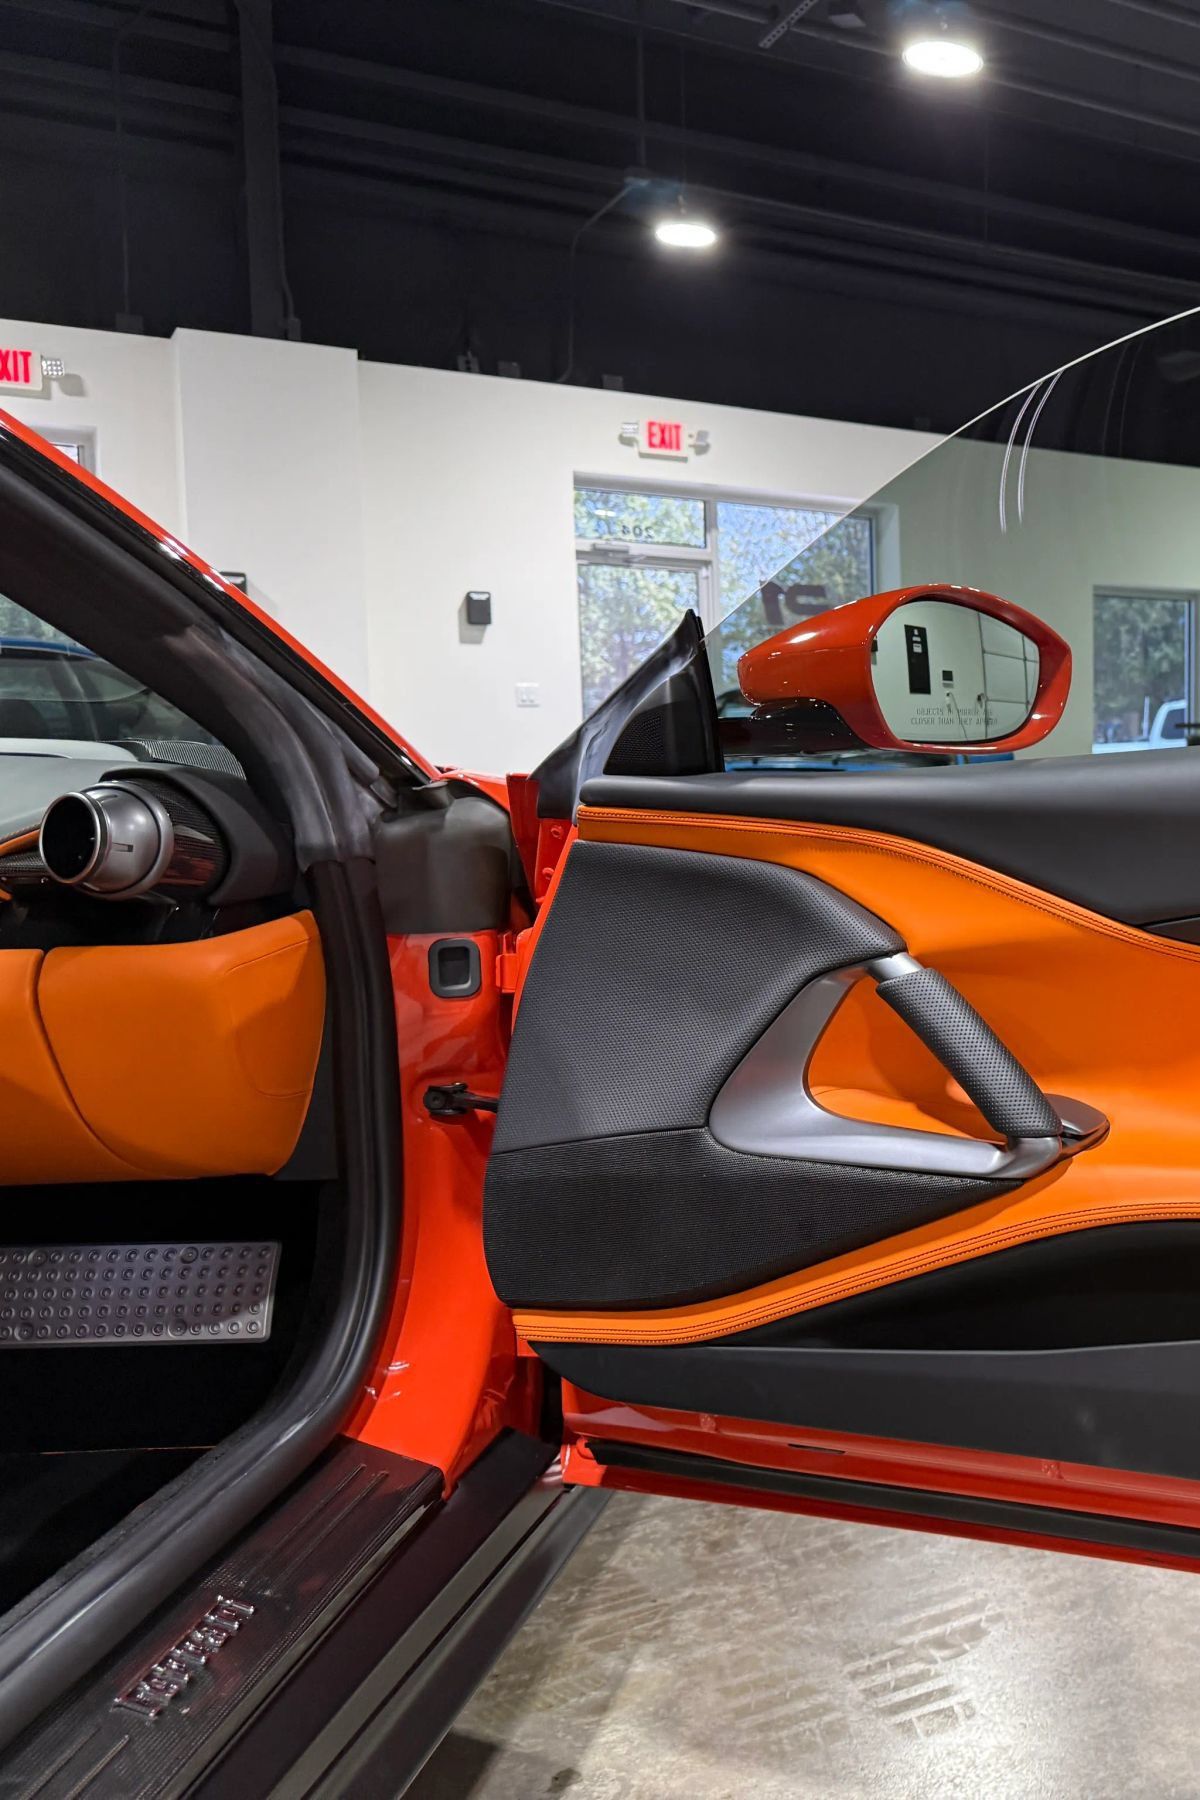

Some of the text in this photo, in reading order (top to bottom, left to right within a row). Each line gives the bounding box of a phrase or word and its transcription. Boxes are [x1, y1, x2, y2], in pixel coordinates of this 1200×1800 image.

[0, 349, 32, 383] XIT
[647, 421, 682, 451] EXIT
[111, 1595, 255, 1721] Ferrari
